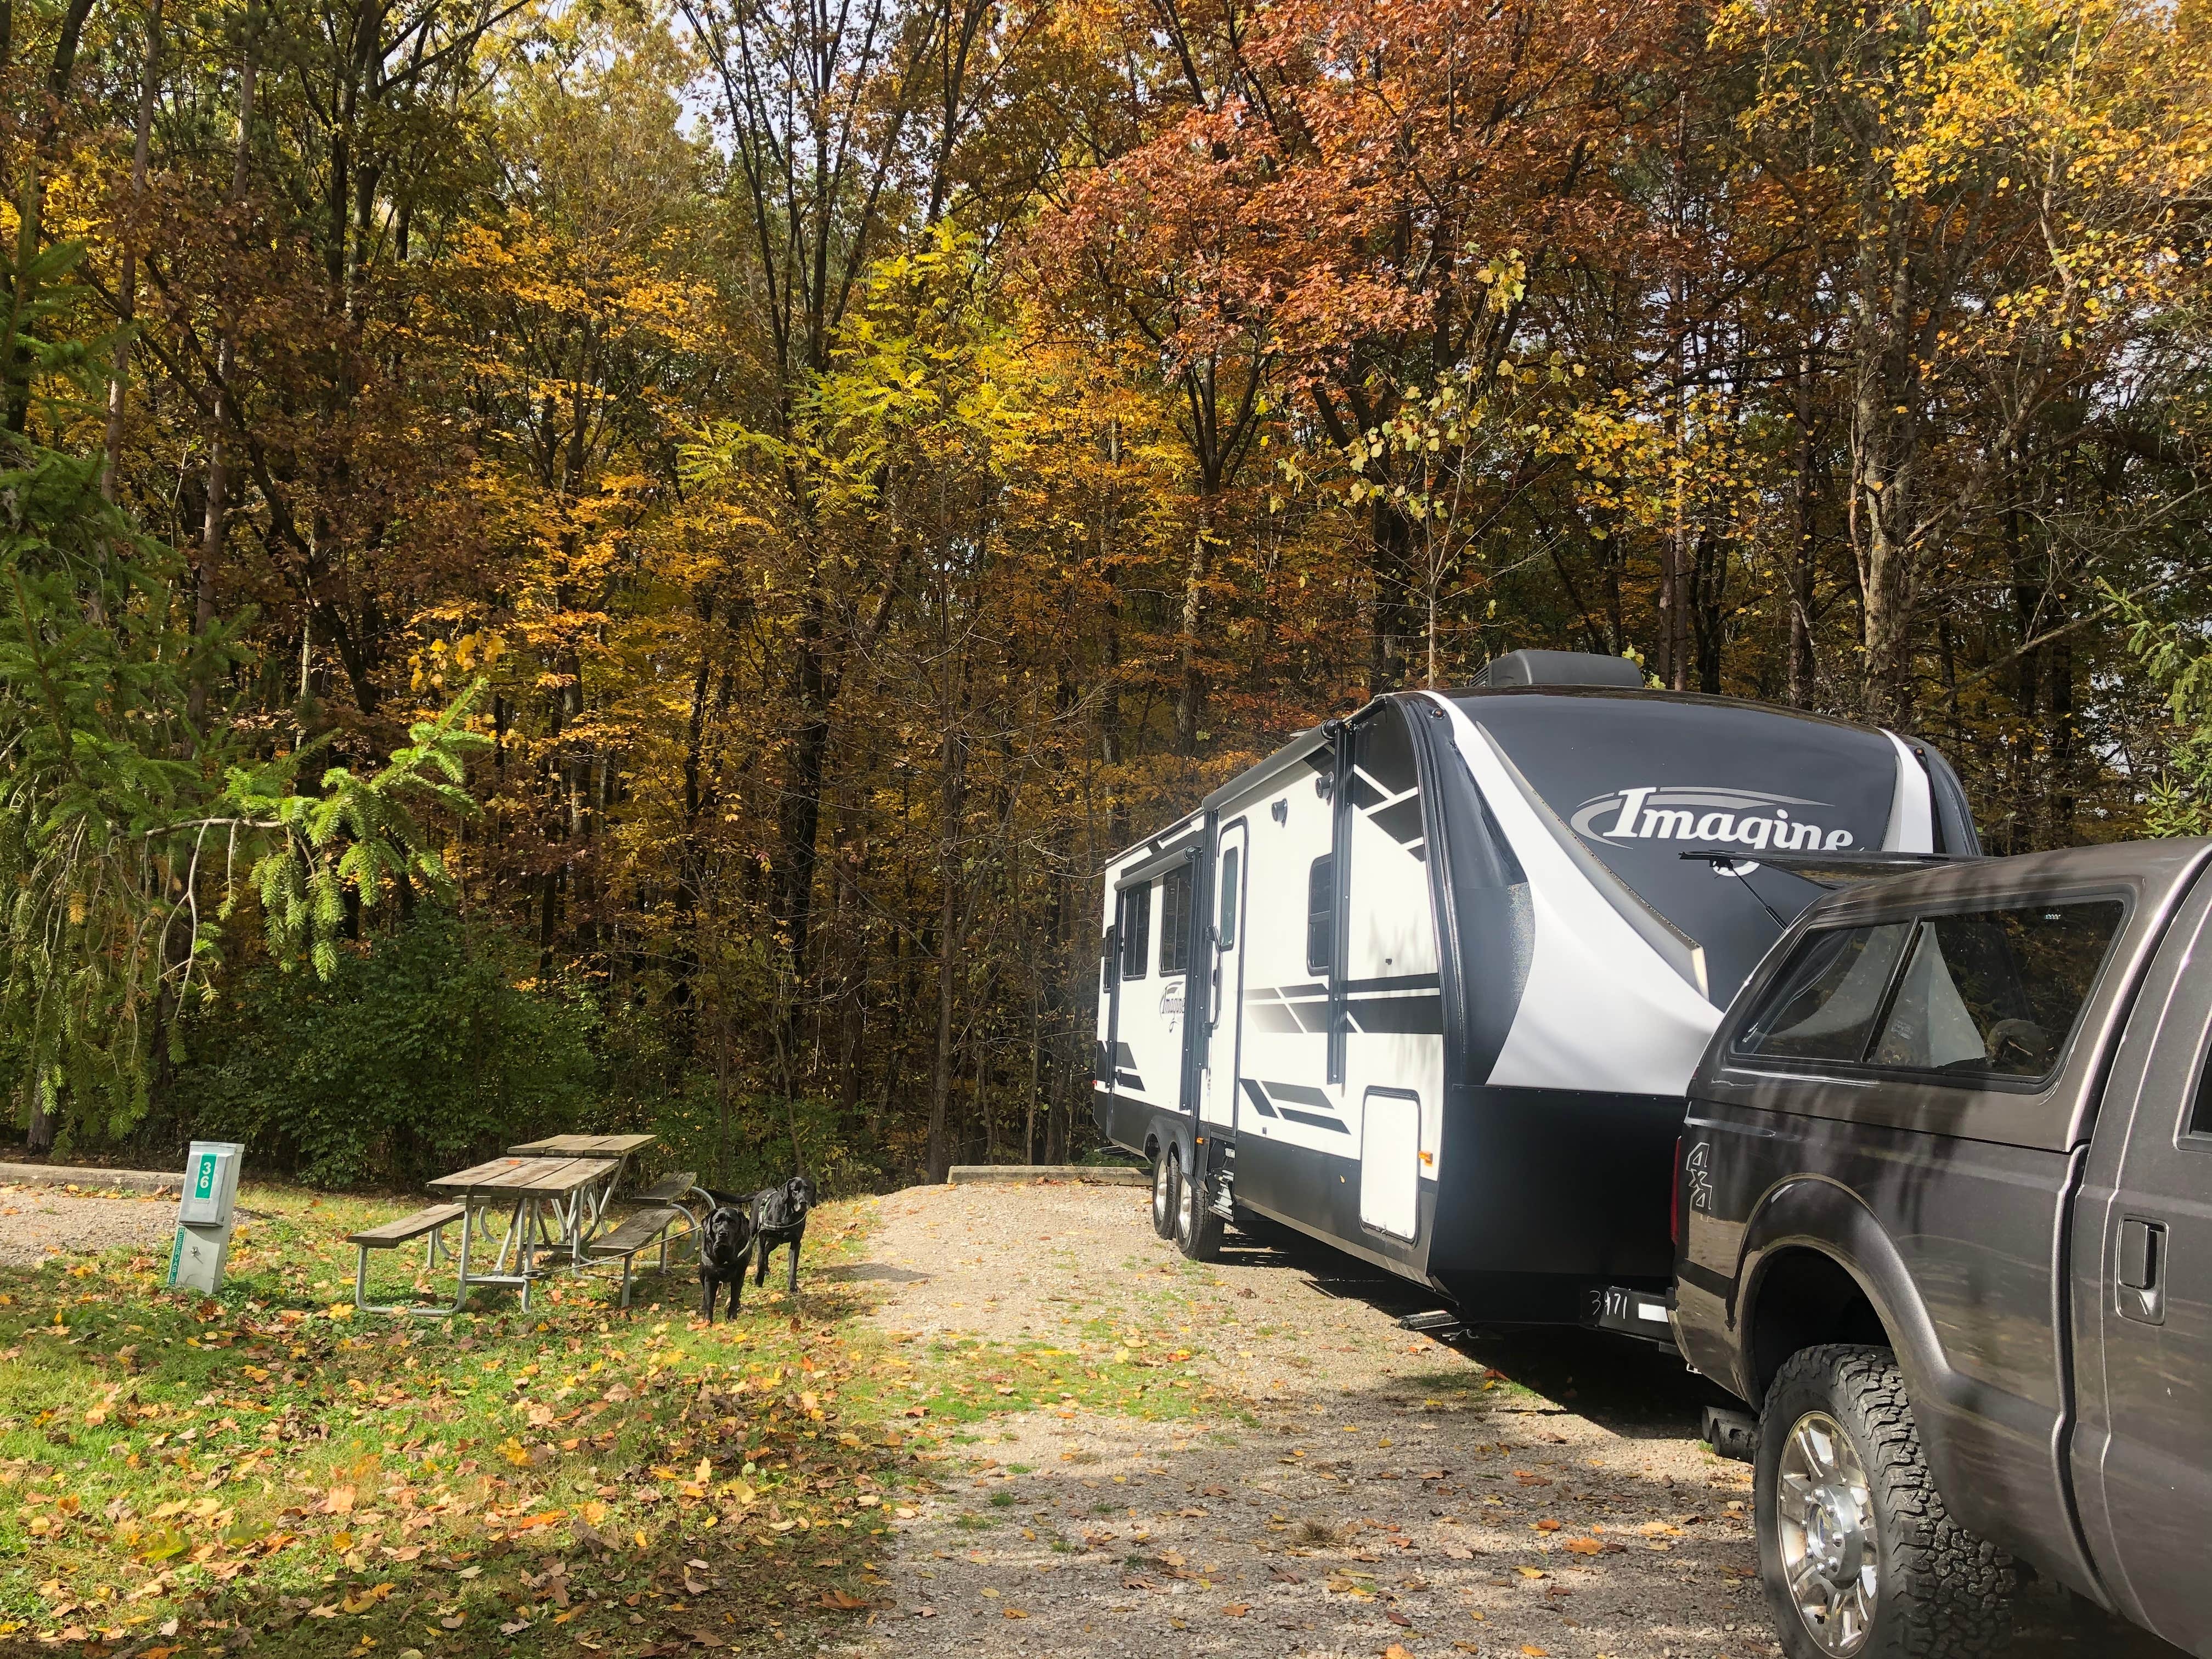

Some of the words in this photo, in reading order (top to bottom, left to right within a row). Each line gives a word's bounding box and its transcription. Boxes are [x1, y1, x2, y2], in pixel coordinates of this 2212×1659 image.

[1602, 787, 1854, 876] Imagine
[200, 1161, 212, 1188] 36
[170, 1228, 185, 1286] RESERVABLE
[1589, 1290, 1628, 1319] 3971
